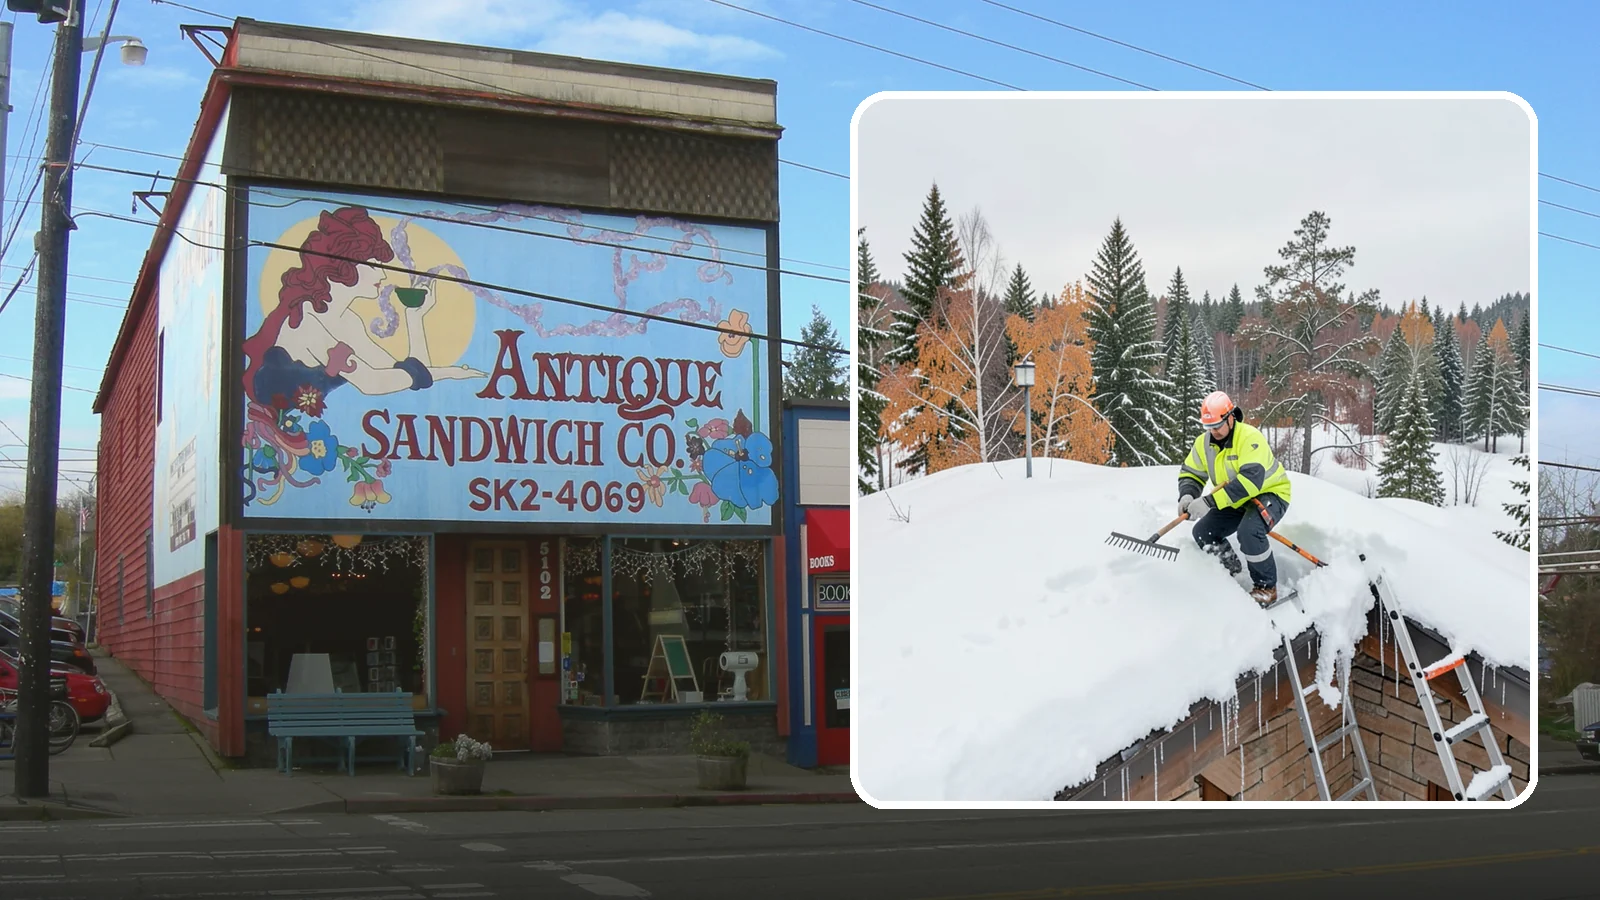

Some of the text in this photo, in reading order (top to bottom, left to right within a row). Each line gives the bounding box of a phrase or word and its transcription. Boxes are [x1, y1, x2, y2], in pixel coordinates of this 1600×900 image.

[477, 329, 722, 420] ANTIQUE
[362, 410, 684, 470] SANDWICH CO.
[469, 477, 645, 513] SK2-4069
[540, 541, 551, 600] 5102
[809, 555, 835, 569] BOOKS
